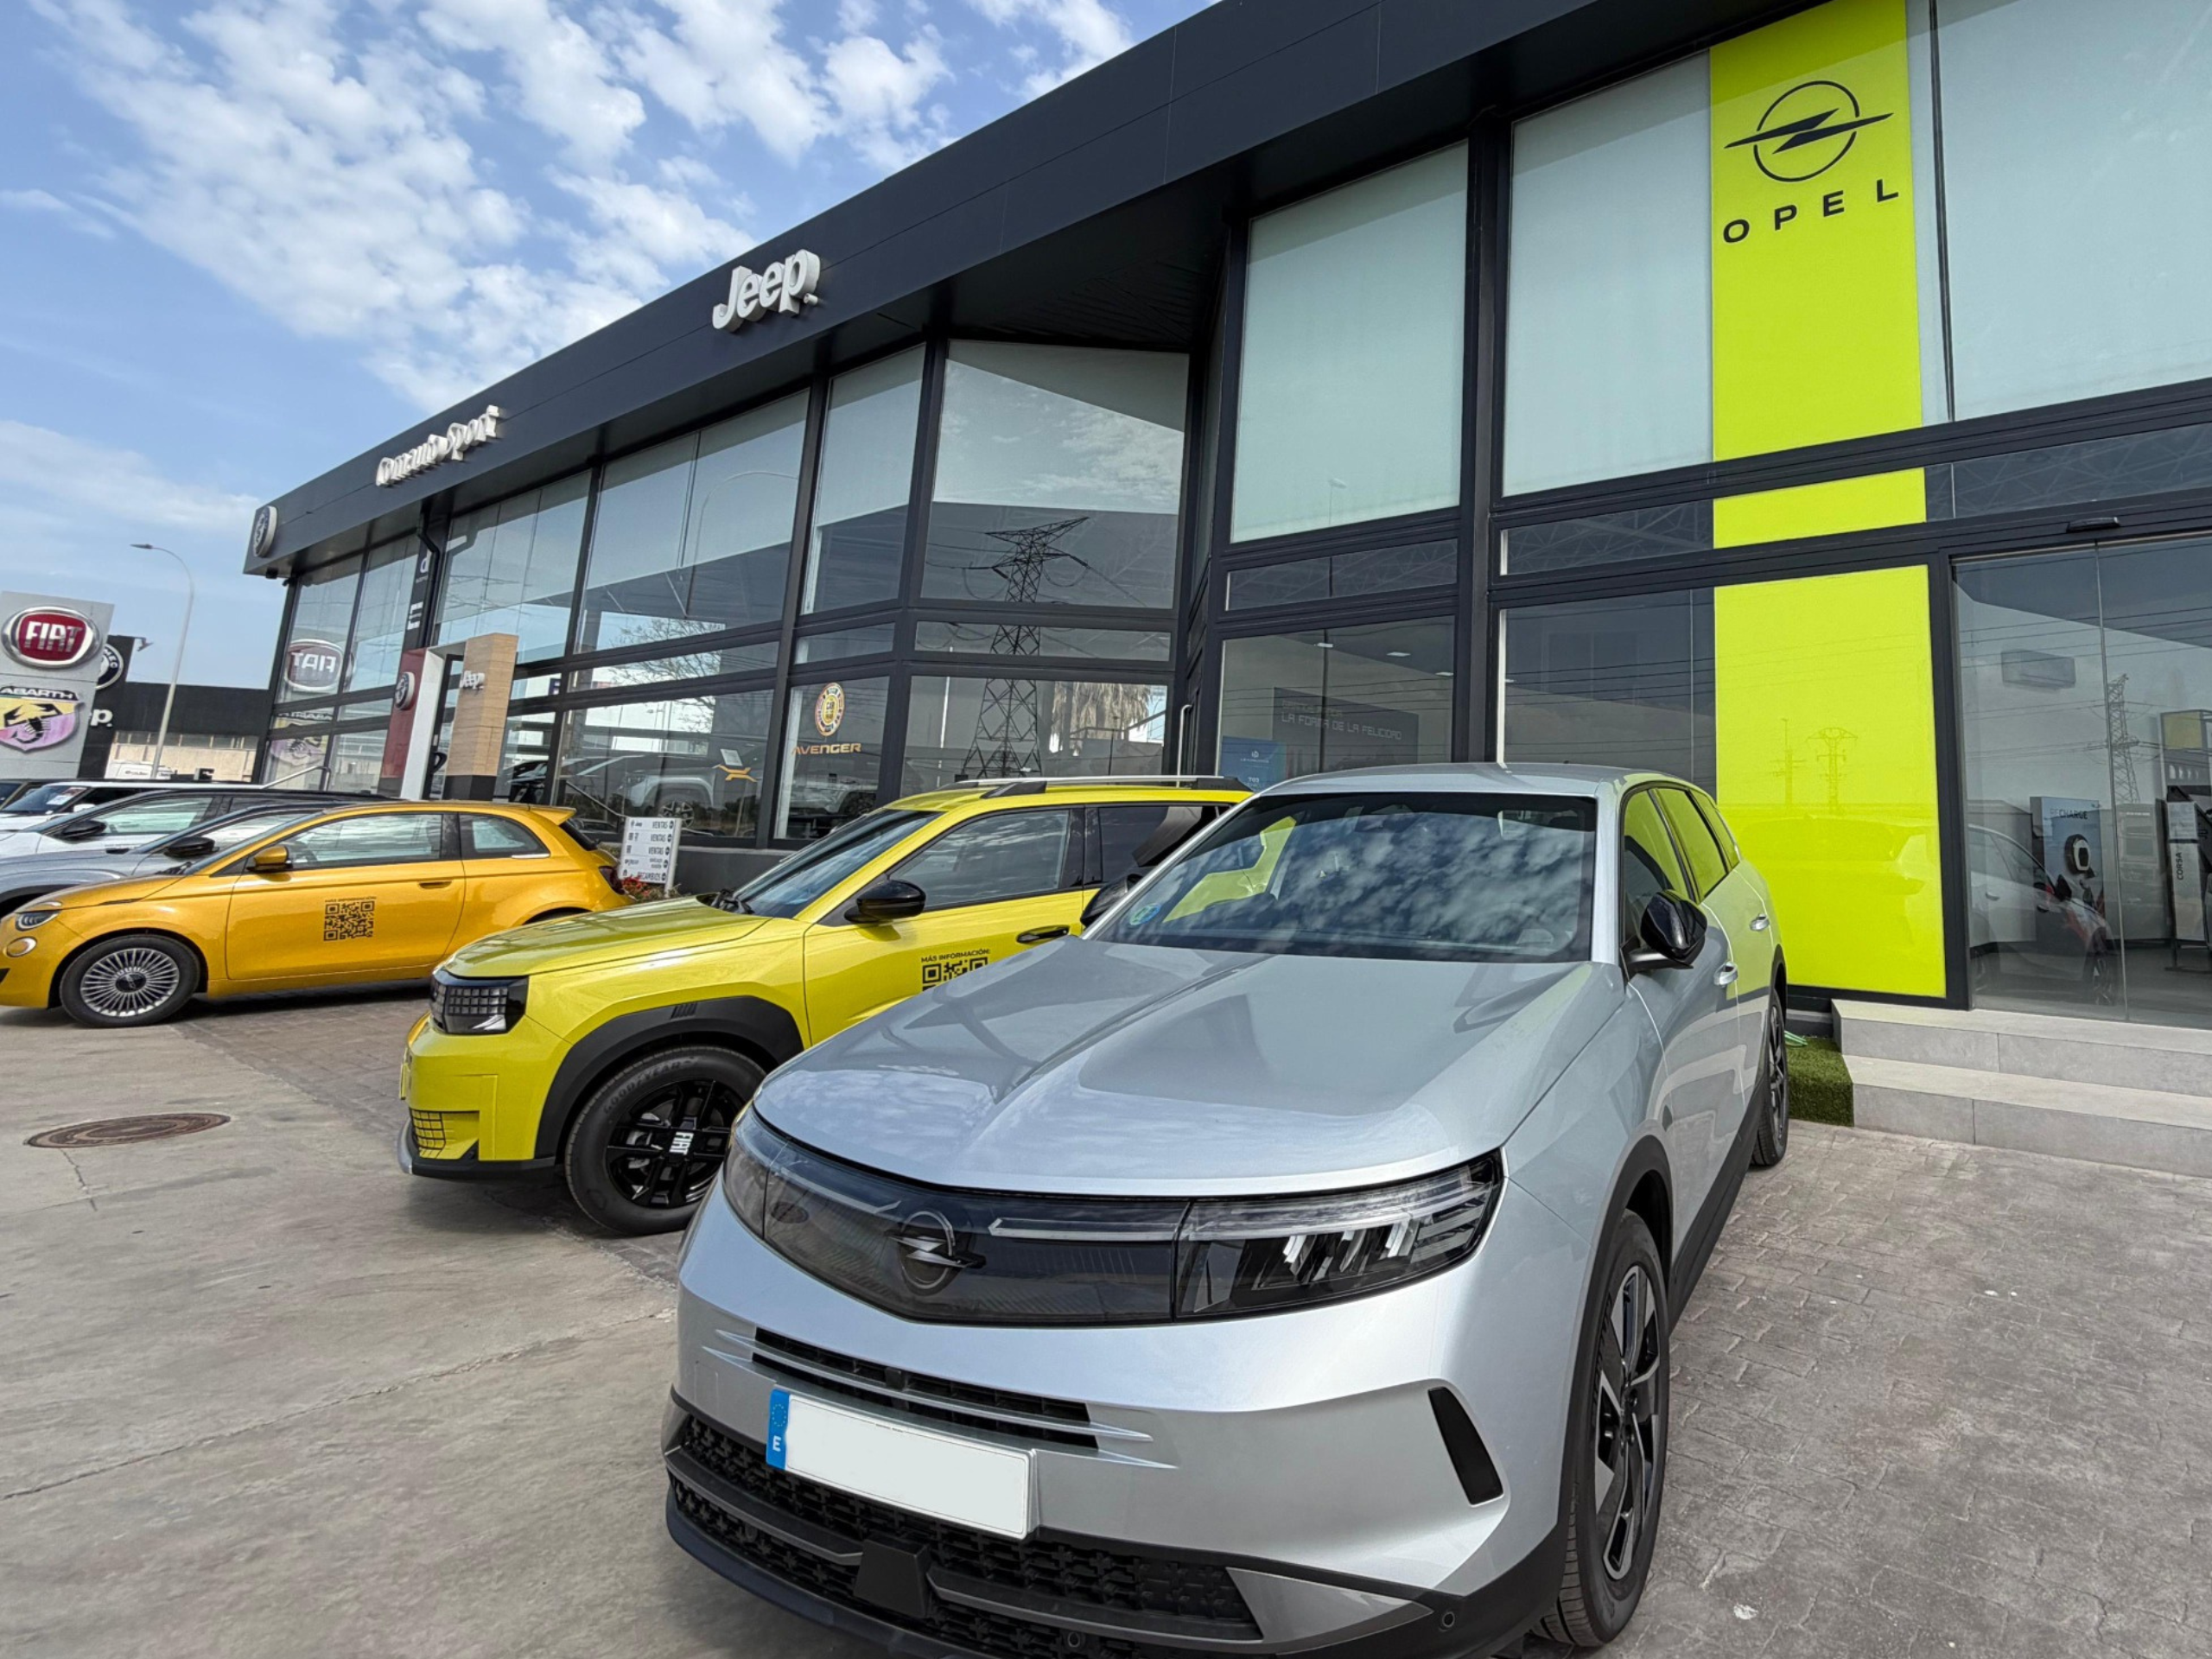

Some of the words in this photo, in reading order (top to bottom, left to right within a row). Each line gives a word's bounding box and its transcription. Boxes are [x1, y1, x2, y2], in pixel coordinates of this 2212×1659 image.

[1723, 179, 1899, 244] OPEL
[24, 621, 83, 653] FIAT
[1, 688, 73, 700] ABARTH
[1281, 711, 1295, 724] LA
[1332, 720, 1344, 731] DE
[1347, 722, 1360, 734] LA
[1362, 725, 1402, 741] FELICIDAD
[792, 743, 861, 755] AVENGER
[2176, 852, 2184, 880] CORSA
[669, 1131, 694, 1155] FIAT
[772, 1435, 782, 1452] E
